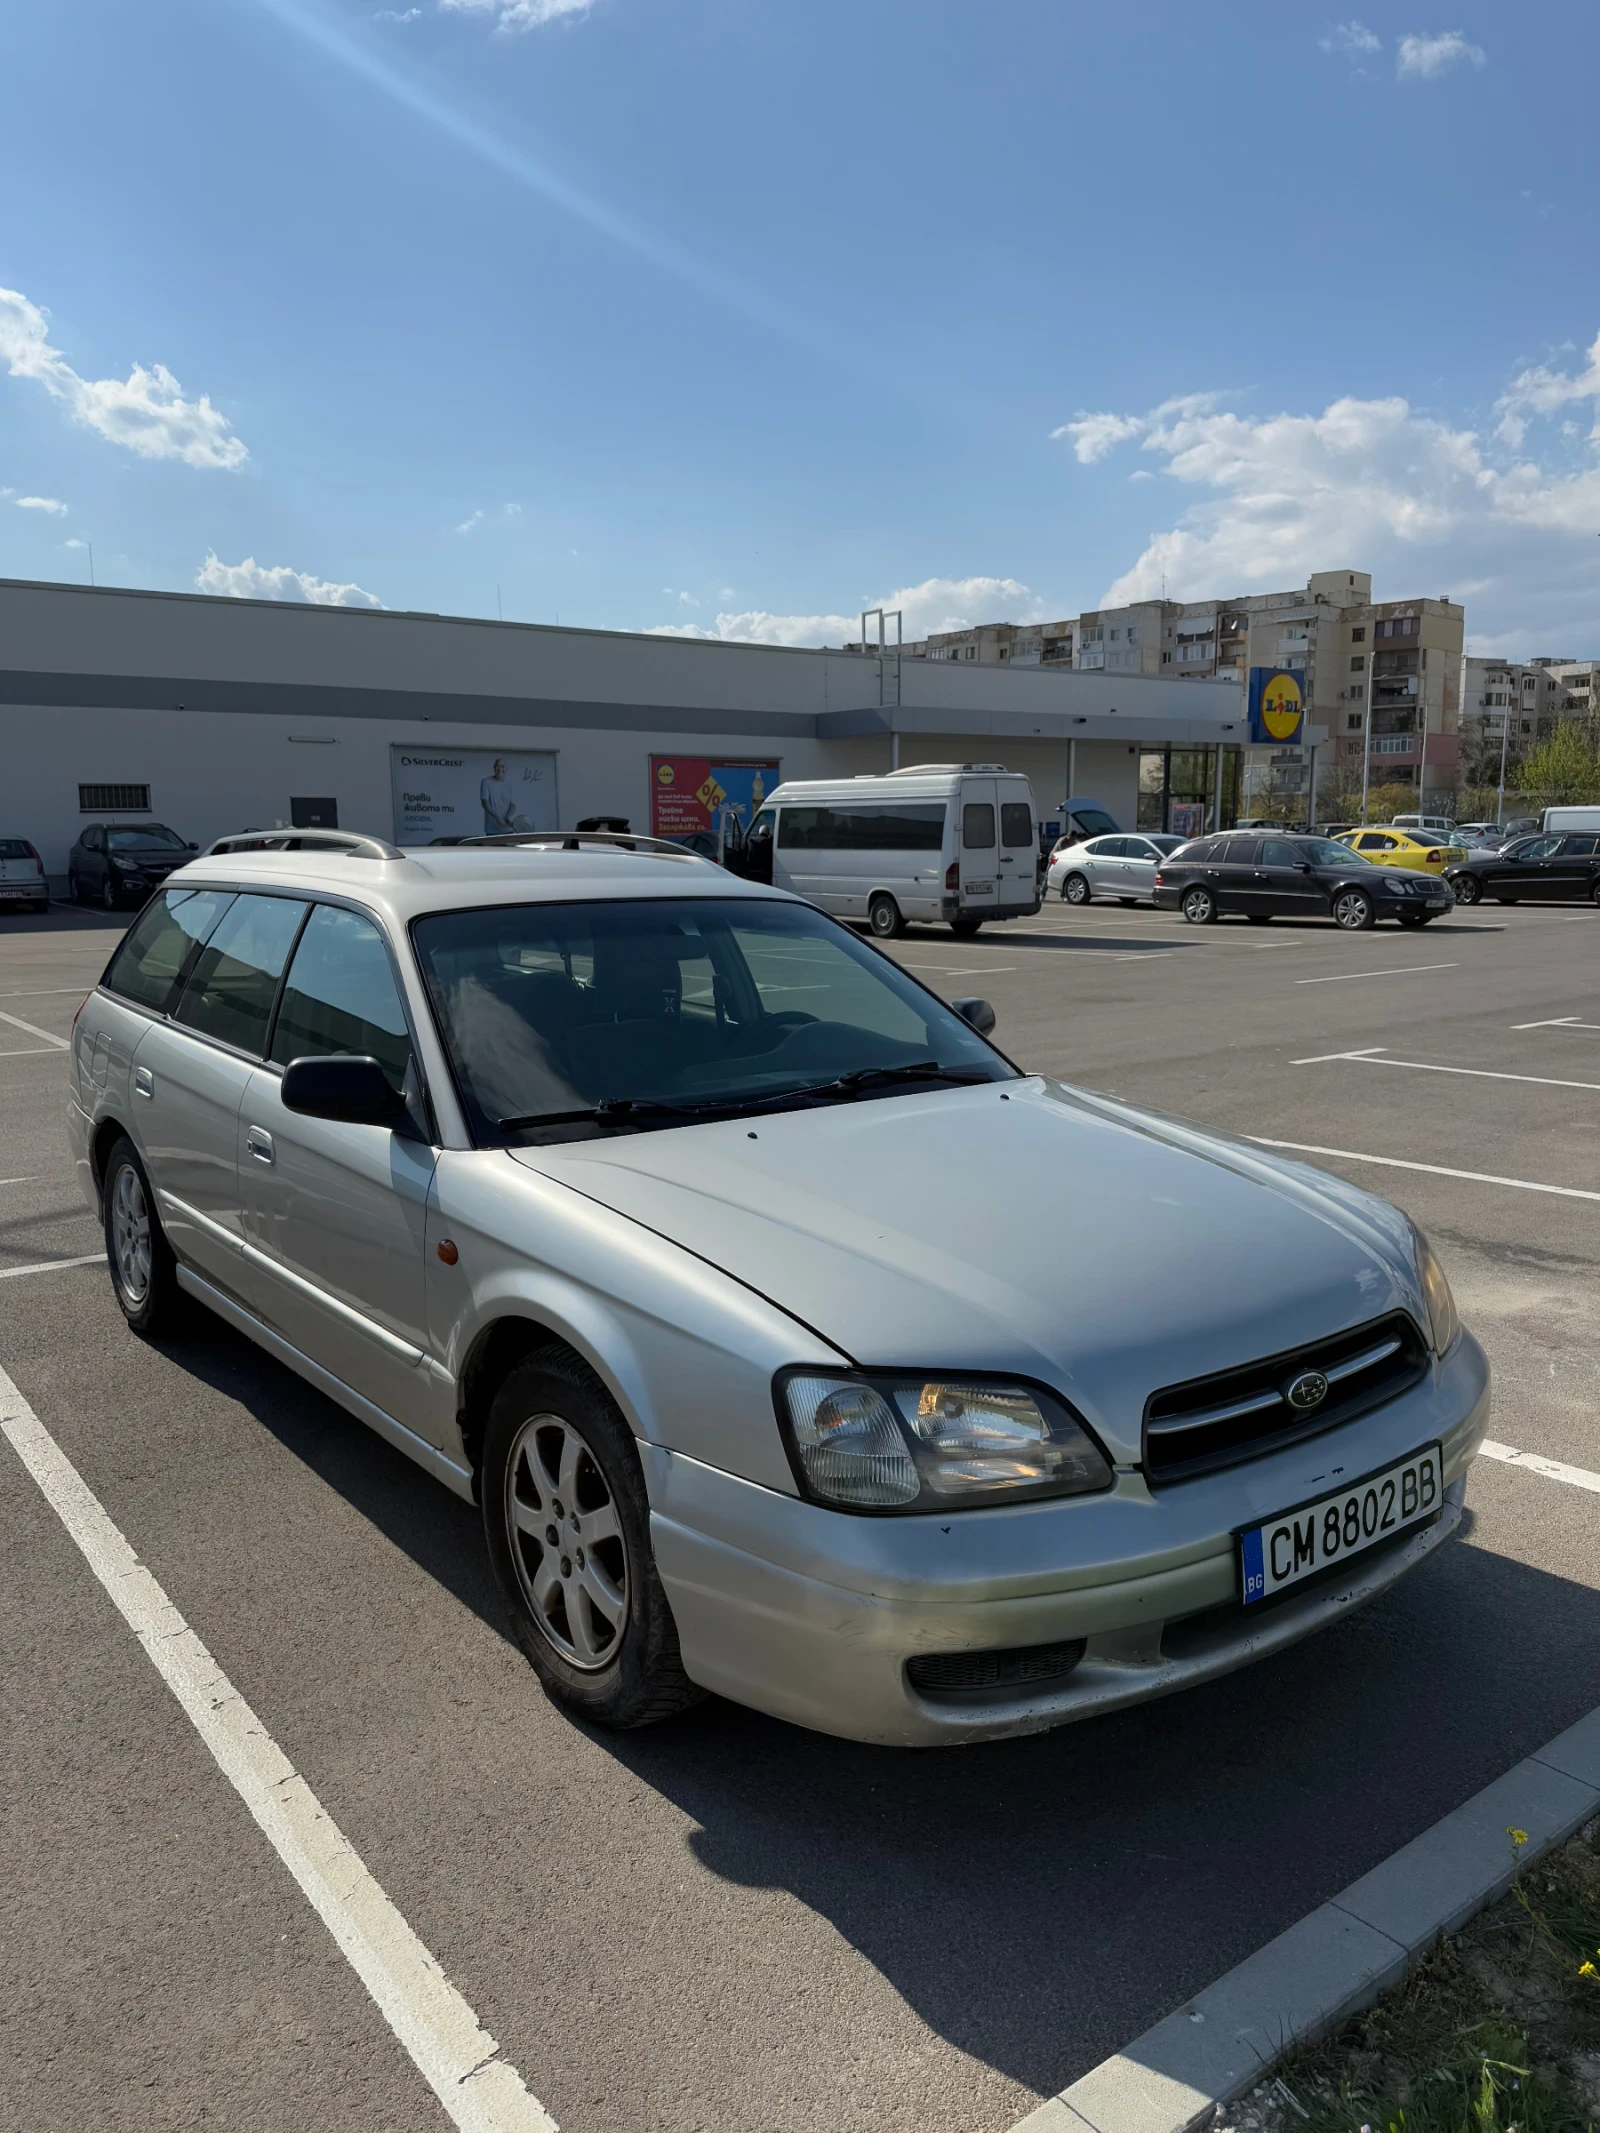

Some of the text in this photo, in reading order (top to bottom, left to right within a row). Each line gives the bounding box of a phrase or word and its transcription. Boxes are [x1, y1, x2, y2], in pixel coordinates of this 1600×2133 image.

[403, 793, 431, 803] Прави
[404, 803, 440, 812] живота
[1247, 1573, 1263, 1593] BG
